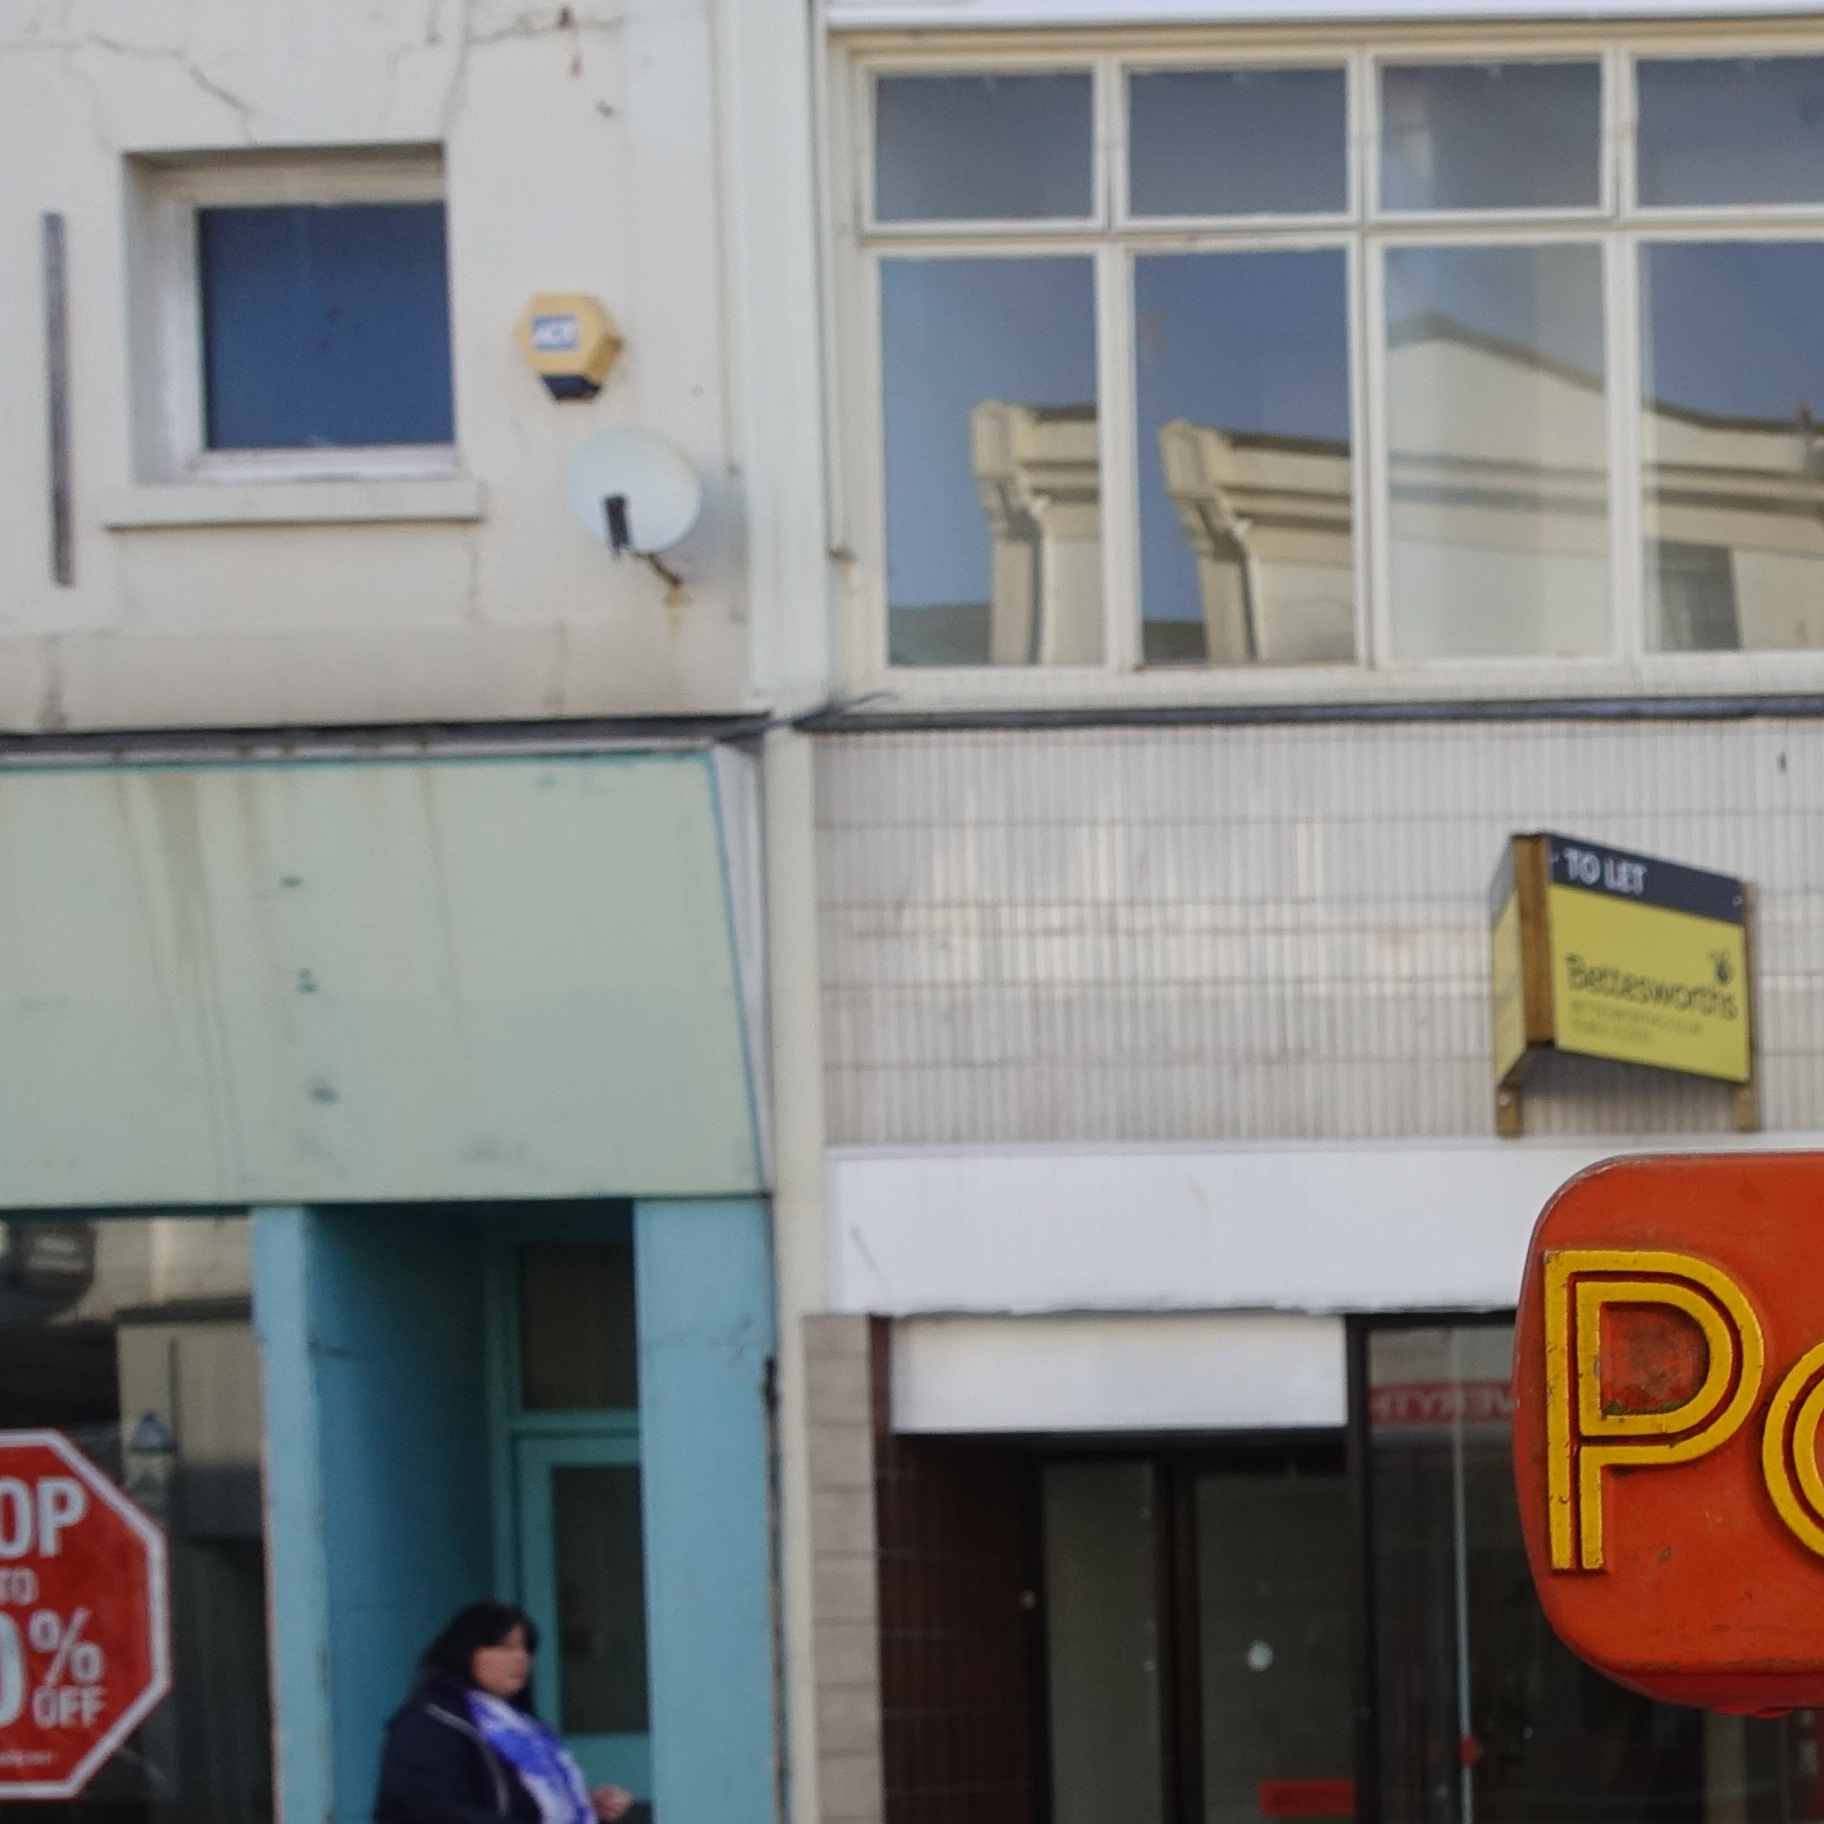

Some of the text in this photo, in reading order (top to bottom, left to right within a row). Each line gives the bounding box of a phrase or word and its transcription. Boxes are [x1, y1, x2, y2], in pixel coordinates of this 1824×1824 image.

[1564, 848, 1648, 894] TO LET
[1566, 953, 1739, 1021] Bettesworths
[33, 1685, 105, 1729] OFF
